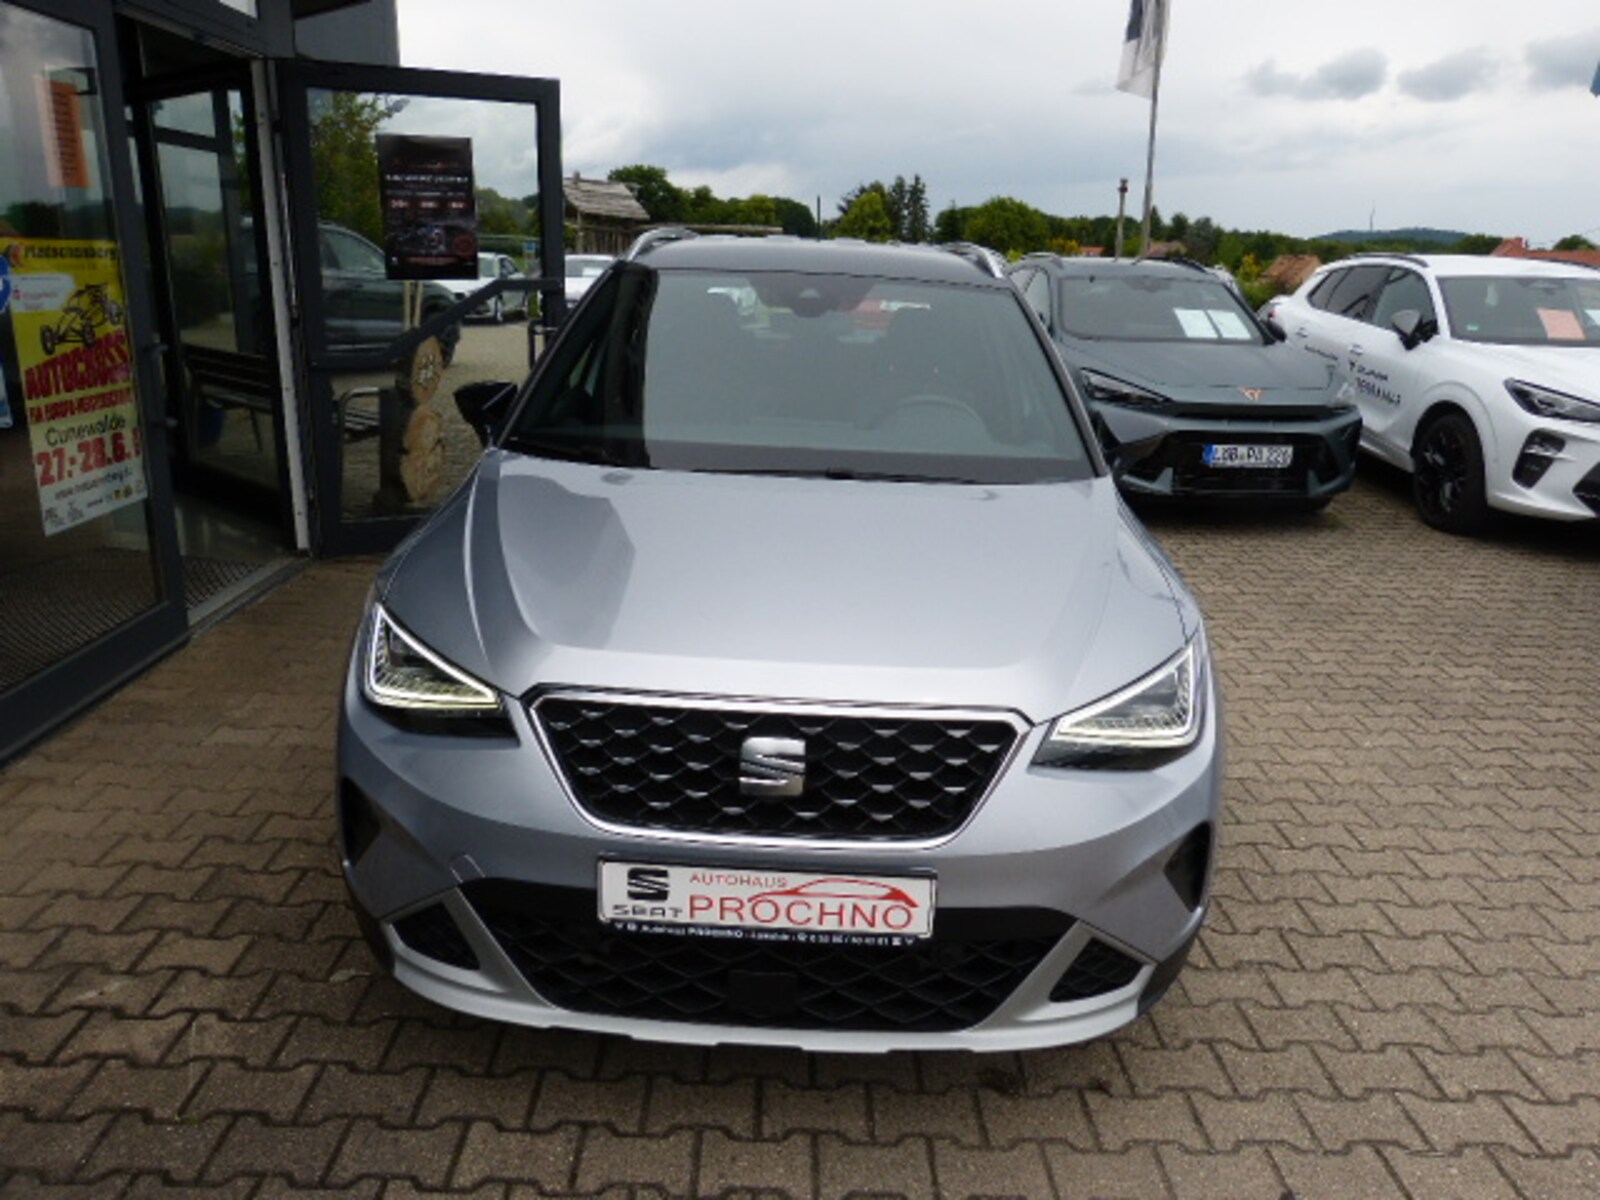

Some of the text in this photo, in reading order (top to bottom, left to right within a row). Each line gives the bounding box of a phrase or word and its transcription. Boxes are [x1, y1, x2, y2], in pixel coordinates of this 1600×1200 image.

[46, 412, 126, 446] Cunewalde
[690, 873, 788, 889] AUTOHAUS
[613, 904, 683, 918] SEAT
[689, 894, 912, 931] PROCHNO
